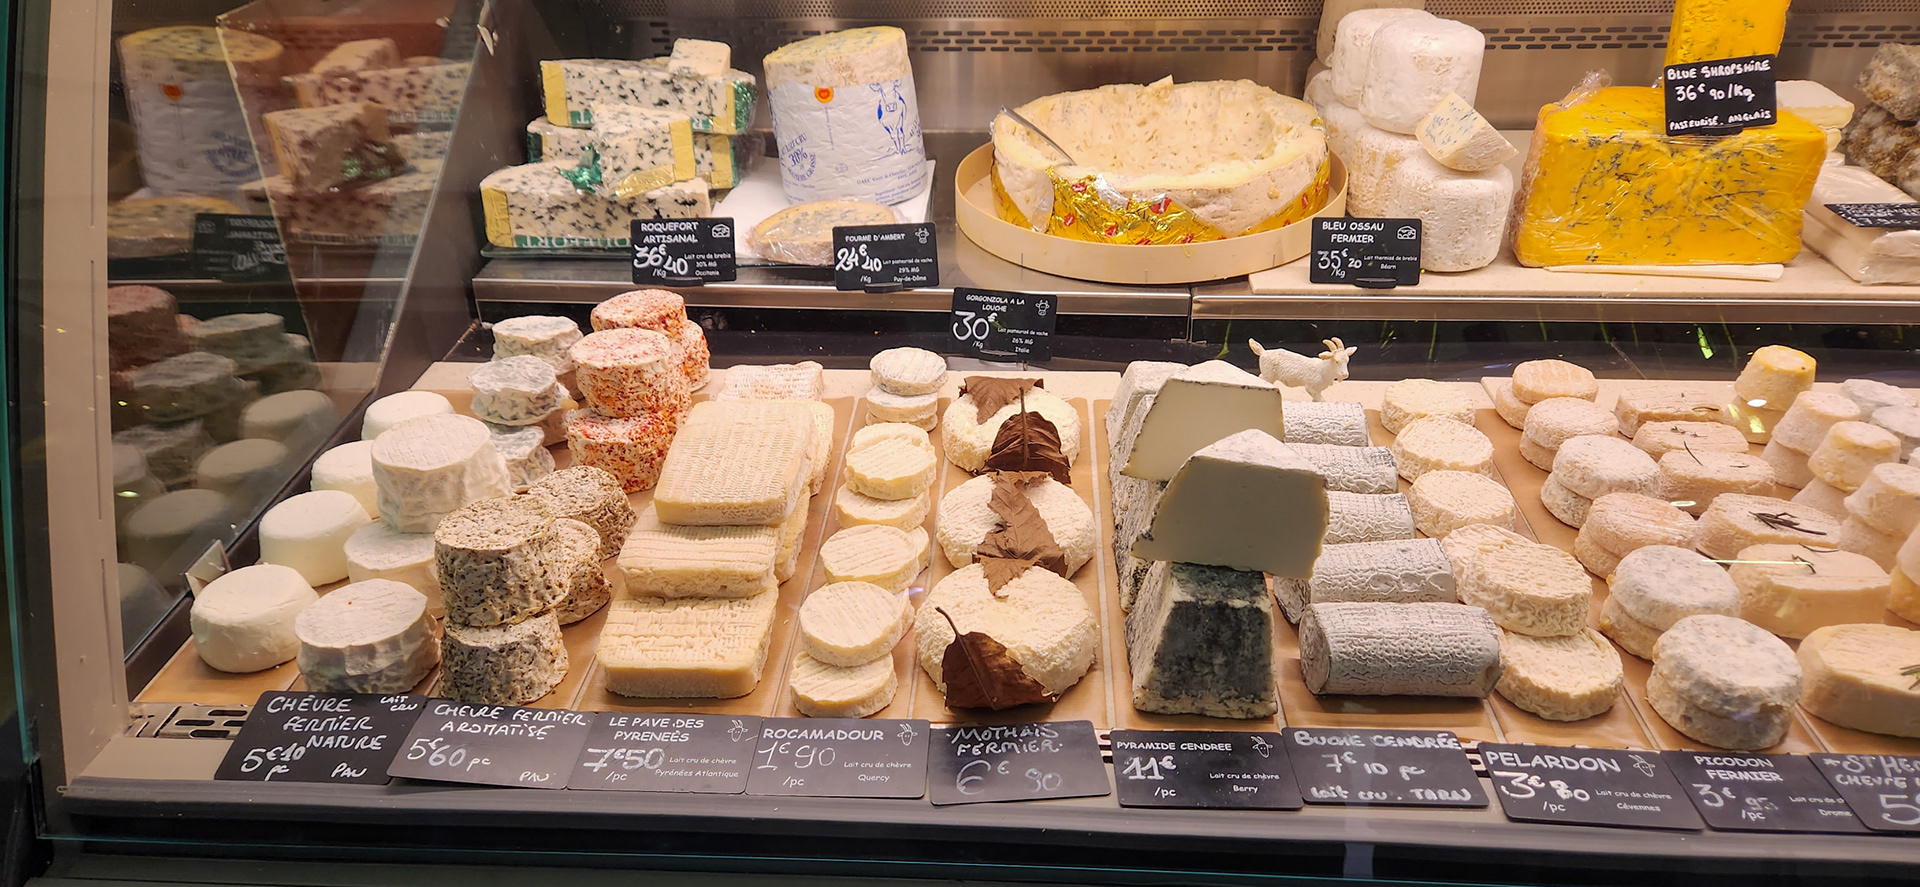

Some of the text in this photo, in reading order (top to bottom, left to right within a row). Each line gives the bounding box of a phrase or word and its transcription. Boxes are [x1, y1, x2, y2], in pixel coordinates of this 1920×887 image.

[1667, 60, 1771, 80] BLUE SHROPSHIRE
[1728, 109, 1772, 124] ANGLAIS
[789, 147, 808, 167] 30%
[641, 221, 699, 233] ROQUEFORT
[1322, 221, 1385, 231] BLEU OSSAU
[643, 233, 699, 244] ARTISANAL
[845, 233, 906, 243] FOURME D'AMBERT
[1330, 233, 1375, 244] FERMIER
[652, 268, 667, 279] /Kg
[860, 275, 872, 283] /Kg
[1331, 268, 1346, 279] /Kg
[966, 294, 1008, 304] GORGONZOLA
[982, 304, 1007, 313] LOUCHE
[971, 340, 984, 349] /Kg
[1015, 346, 1030, 354] Italie
[380, 695, 409, 705] LAIT
[389, 702, 418, 712] CRU
[609, 716, 705, 729] LE PAVE DES
[762, 728, 884, 741] ROCAMADOUR
[306, 735, 387, 751] NATURE
[1116, 741, 1233, 752] PYRAMIDE CENDREE
[467, 757, 492, 772] pc
[669, 756, 686, 764] Lait
[711, 757, 737, 765] chèvre
[843, 761, 860, 769] Lait
[874, 761, 885, 769] de
[885, 761, 913, 769] chèvre
[1485, 751, 1622, 773] PELARDON
[1694, 756, 1774, 768] PICODON
[604, 770, 628, 783] /pc
[654, 768, 739, 778] Pyrénées Atlantique
[857, 774, 891, 783] Quercy
[1209, 772, 1225, 780] Lait
[1252, 773, 1281, 781] chèvre
[1705, 769, 1784, 783] FERMIER
[782, 775, 805, 788] /pc
[1154, 787, 1177, 799] /pc
[1233, 784, 1259, 794] Berry
[1595, 789, 1612, 797] Lait
[1630, 790, 1642, 799] de
[1642, 791, 1673, 801] chèvre
[1788, 795, 1807, 803] Lait
[1542, 801, 1567, 813] /pc
[1616, 801, 1662, 813] Cévennes
[1741, 809, 1766, 822] /pc
